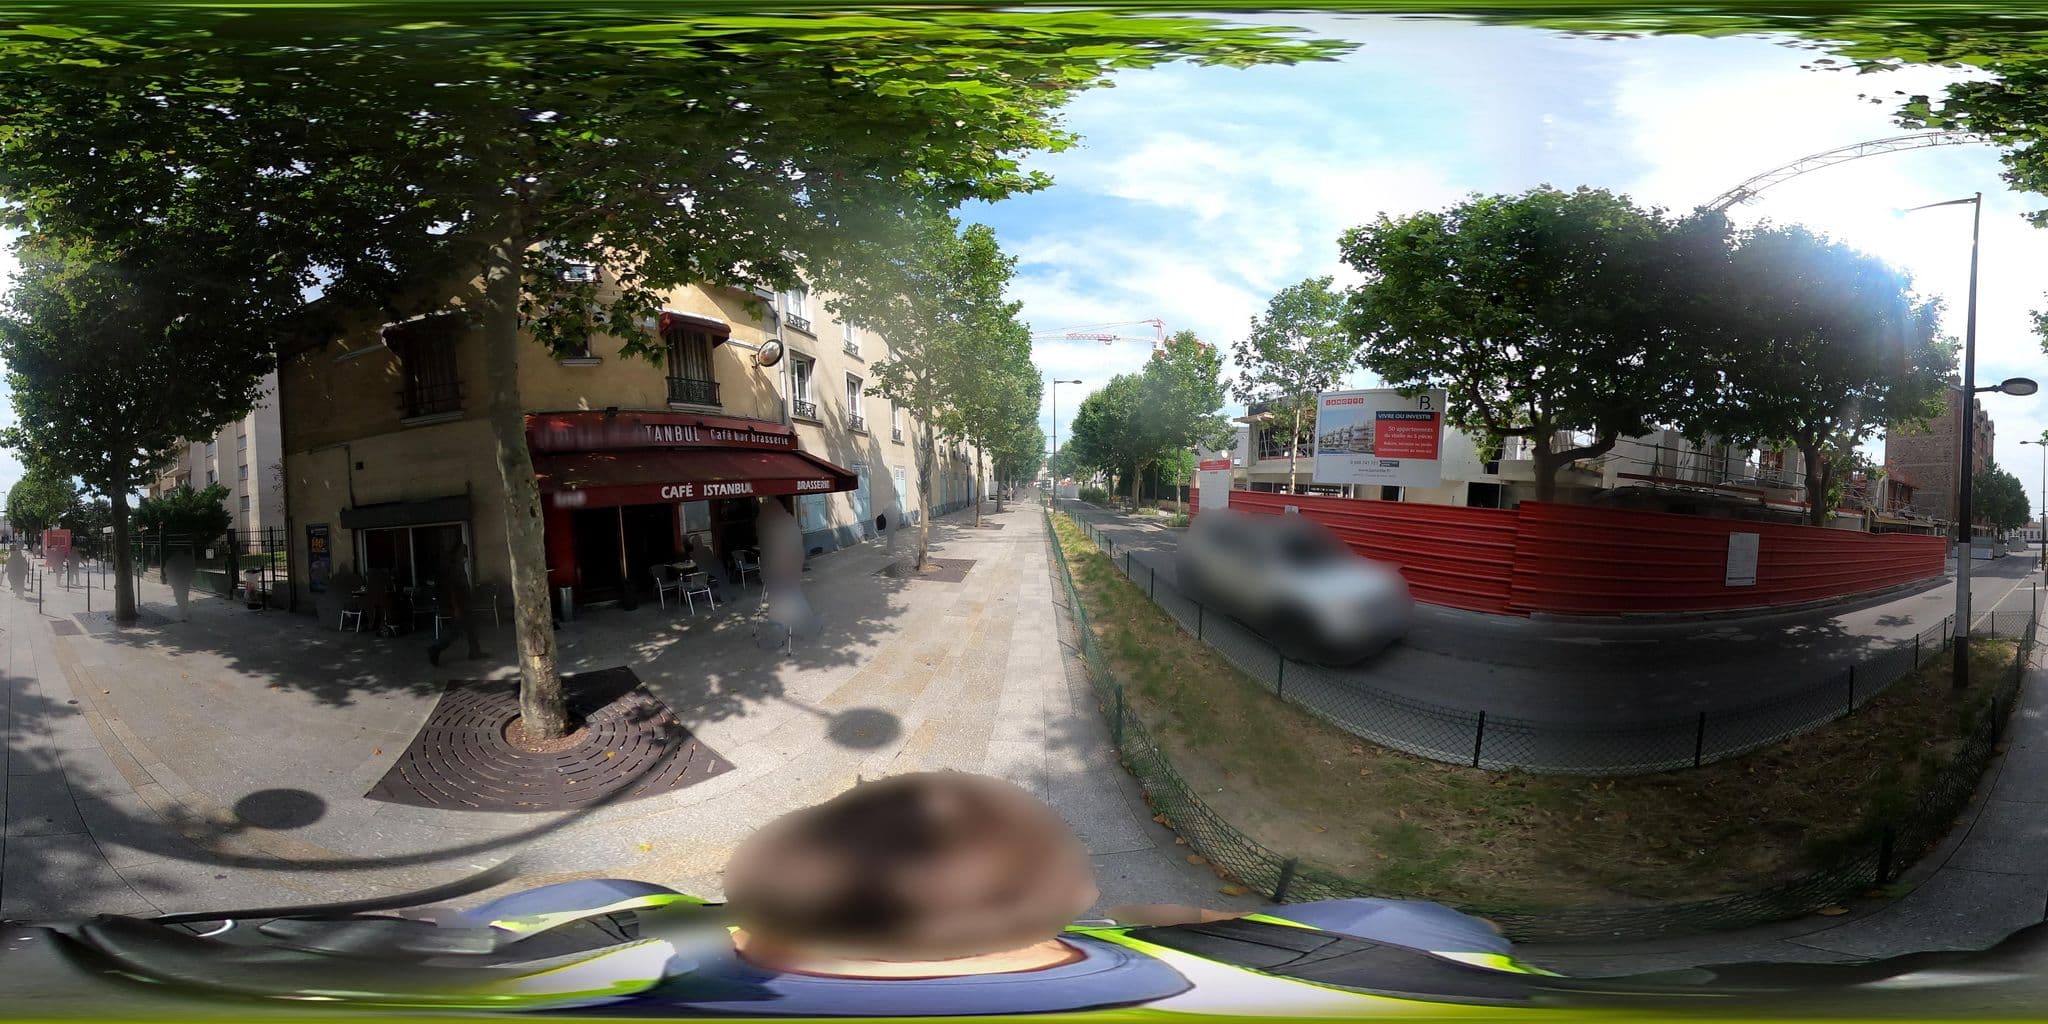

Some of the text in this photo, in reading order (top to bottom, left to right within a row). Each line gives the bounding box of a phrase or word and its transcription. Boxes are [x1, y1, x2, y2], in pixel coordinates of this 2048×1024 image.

[643, 425, 700, 442] TANBUL
[710, 428, 732, 441] Café
[734, 431, 749, 442] bar
[751, 433, 789, 445] brasserie
[661, 482, 754, 499] CAFÉ ISTANBUL
[796, 480, 831, 491] BRASSERIE
